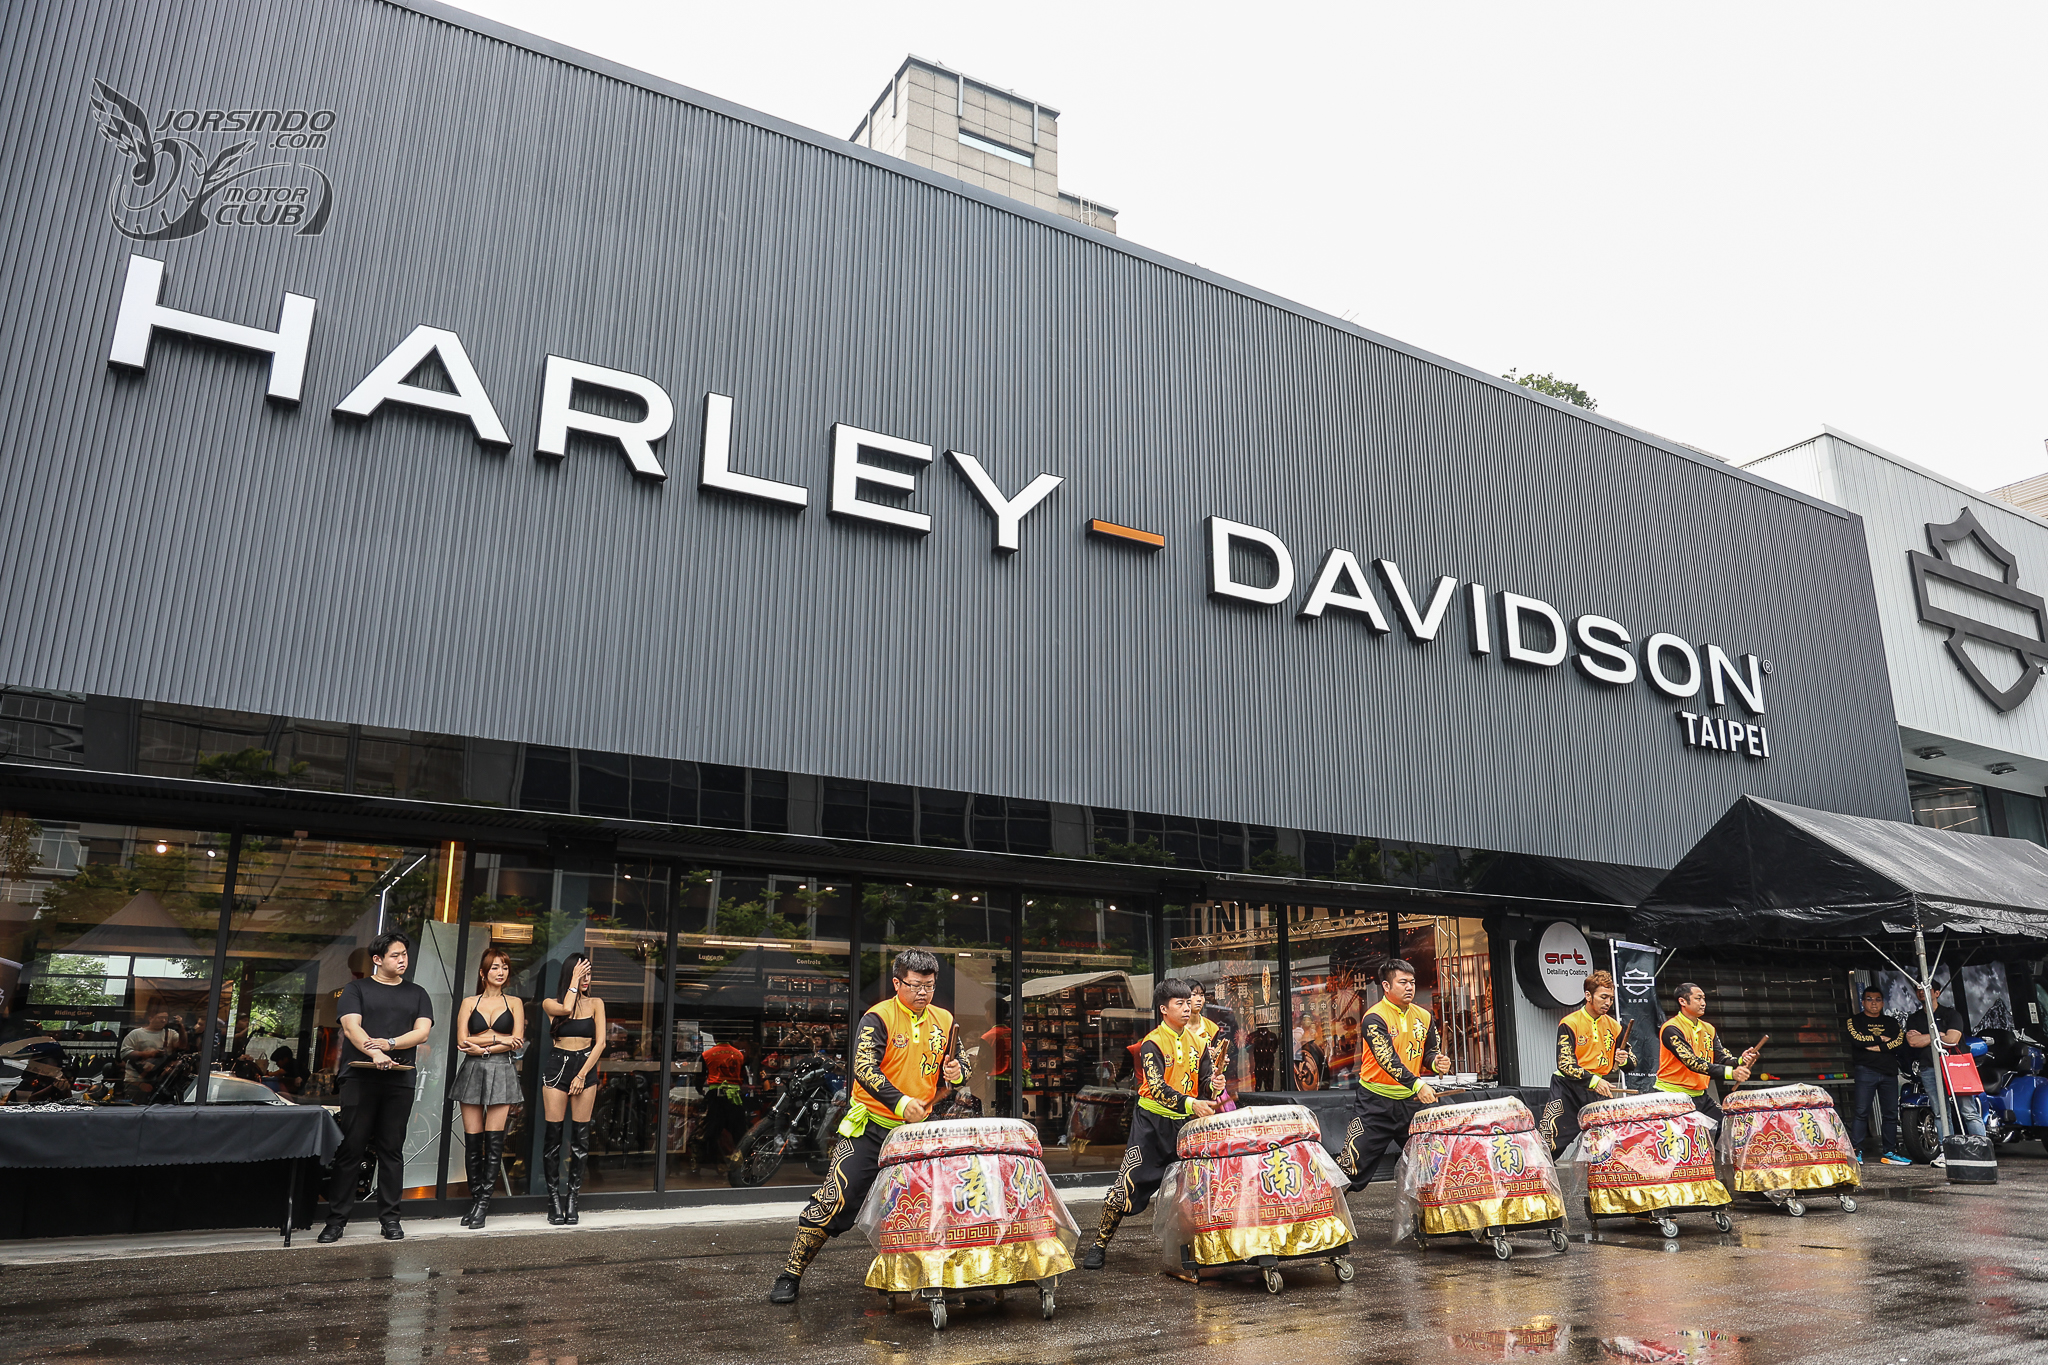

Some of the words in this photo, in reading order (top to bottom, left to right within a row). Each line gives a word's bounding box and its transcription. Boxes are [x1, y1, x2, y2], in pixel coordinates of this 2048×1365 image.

[1680, 711, 1770, 758] TAIPEI
[698, 953, 724, 961] Luggage
[1545, 948, 1587, 966] art
[1546, 968, 1569, 976] Detailing
[1569, 968, 1588, 977] Coating
[54, 1009, 76, 1017] Riding
